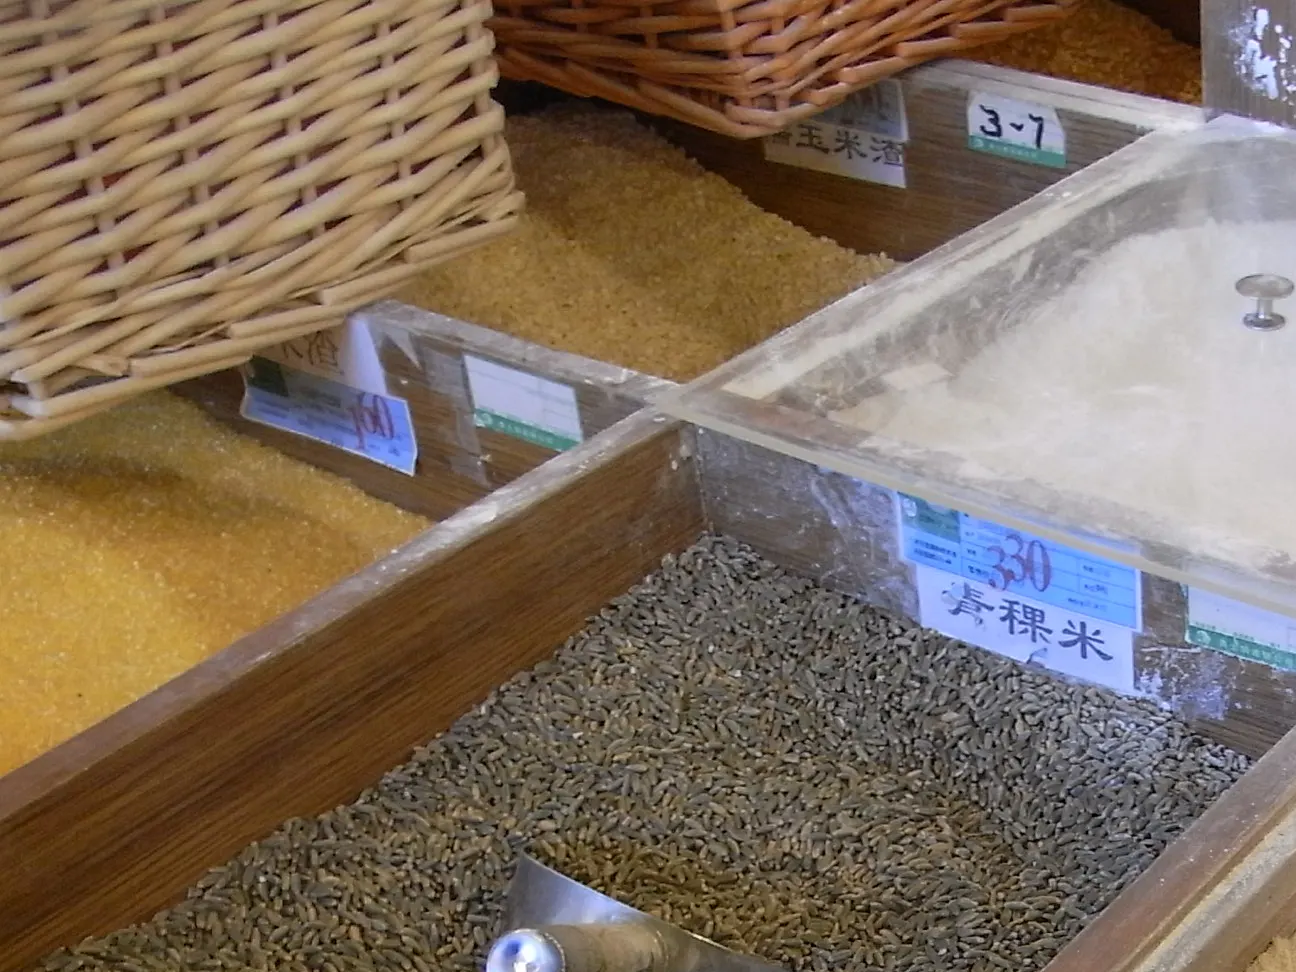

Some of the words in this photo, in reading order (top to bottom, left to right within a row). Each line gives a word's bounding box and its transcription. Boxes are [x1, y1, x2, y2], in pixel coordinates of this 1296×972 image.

[979, 103, 1045, 149] 3-7
[987, 533, 1052, 592] 330
[942, 581, 1114, 661] 青稞米
